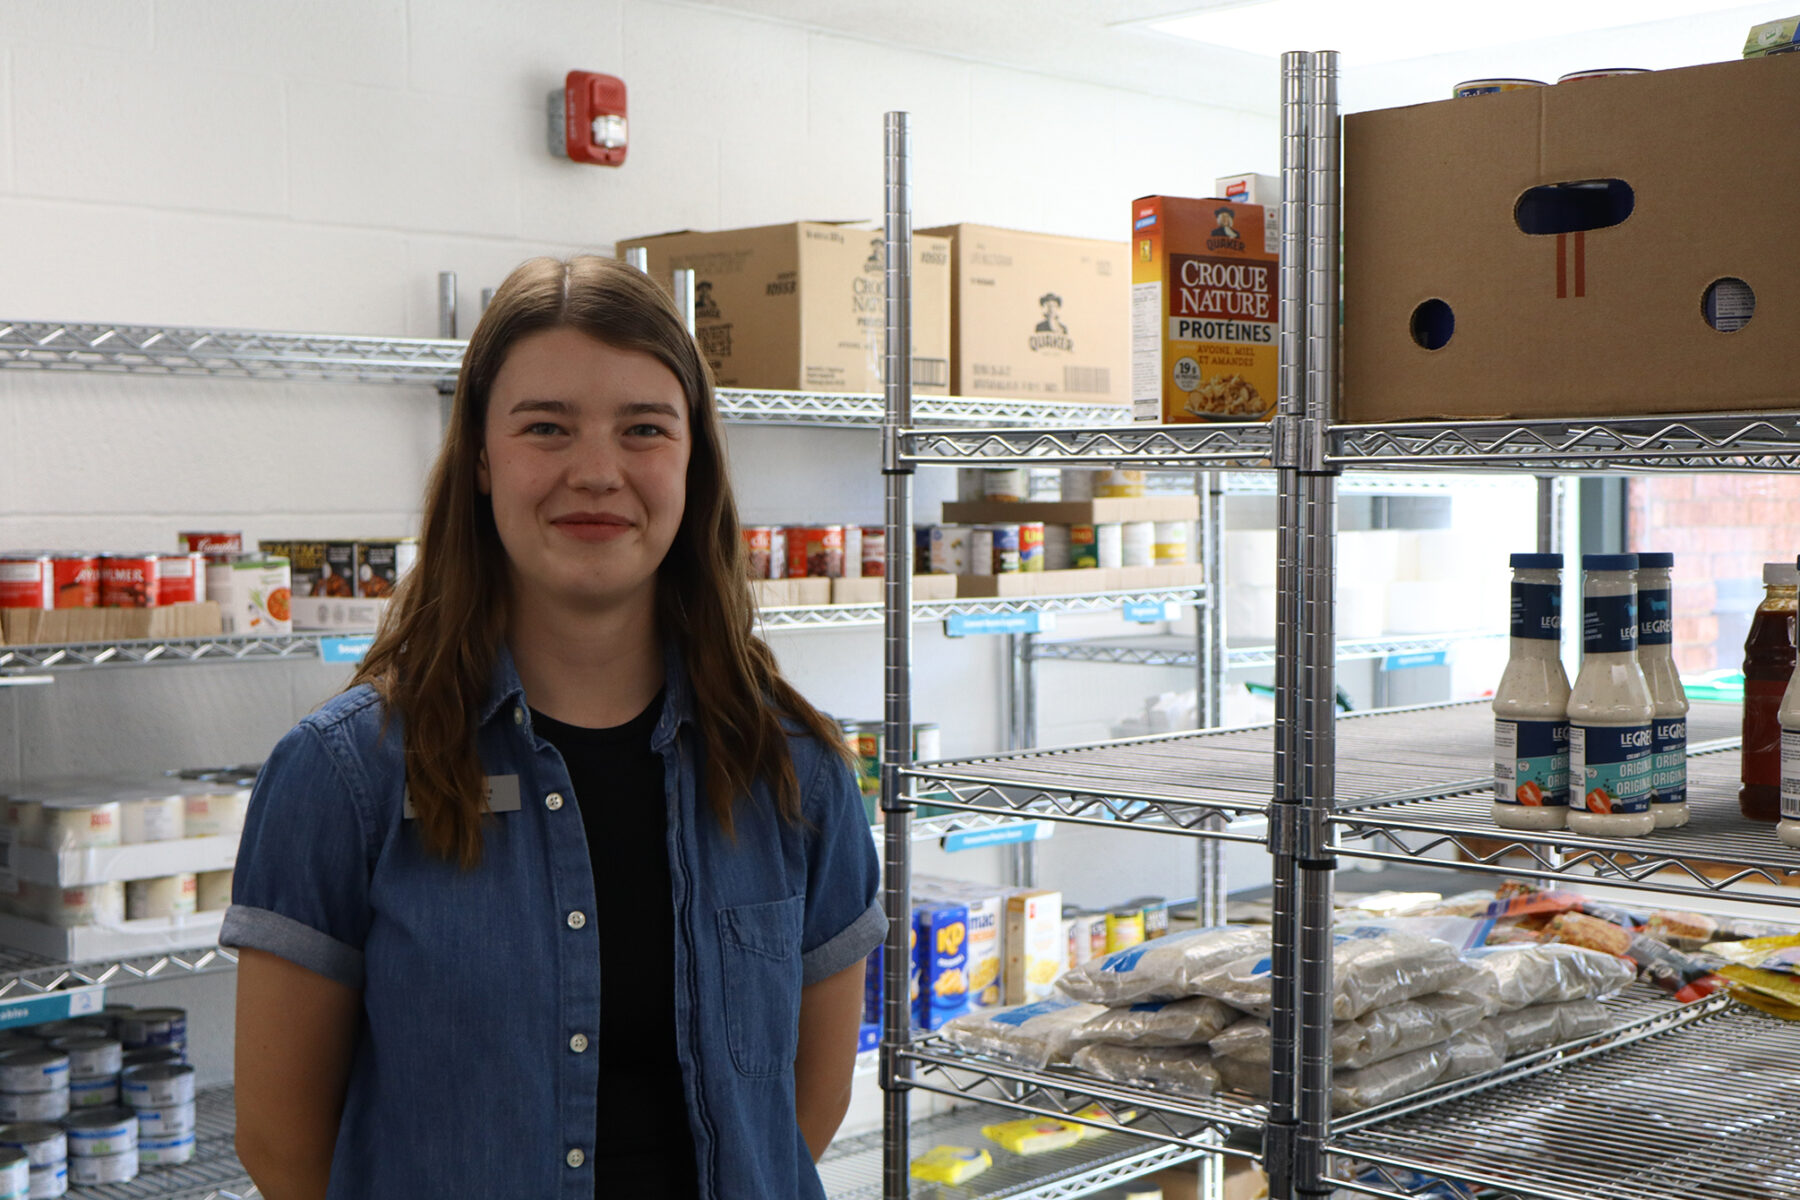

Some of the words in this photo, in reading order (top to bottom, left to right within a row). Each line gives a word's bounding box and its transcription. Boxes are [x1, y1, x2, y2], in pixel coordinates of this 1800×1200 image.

[1206, 238, 1246, 251] QUAKER
[1181, 259, 1268, 293] CROQUE
[1180, 287, 1270, 318] NATURE
[1179, 319, 1272, 342] PROTÉINES
[1029, 334, 1074, 352] QUAKER
[1179, 362, 1191, 374] 19
